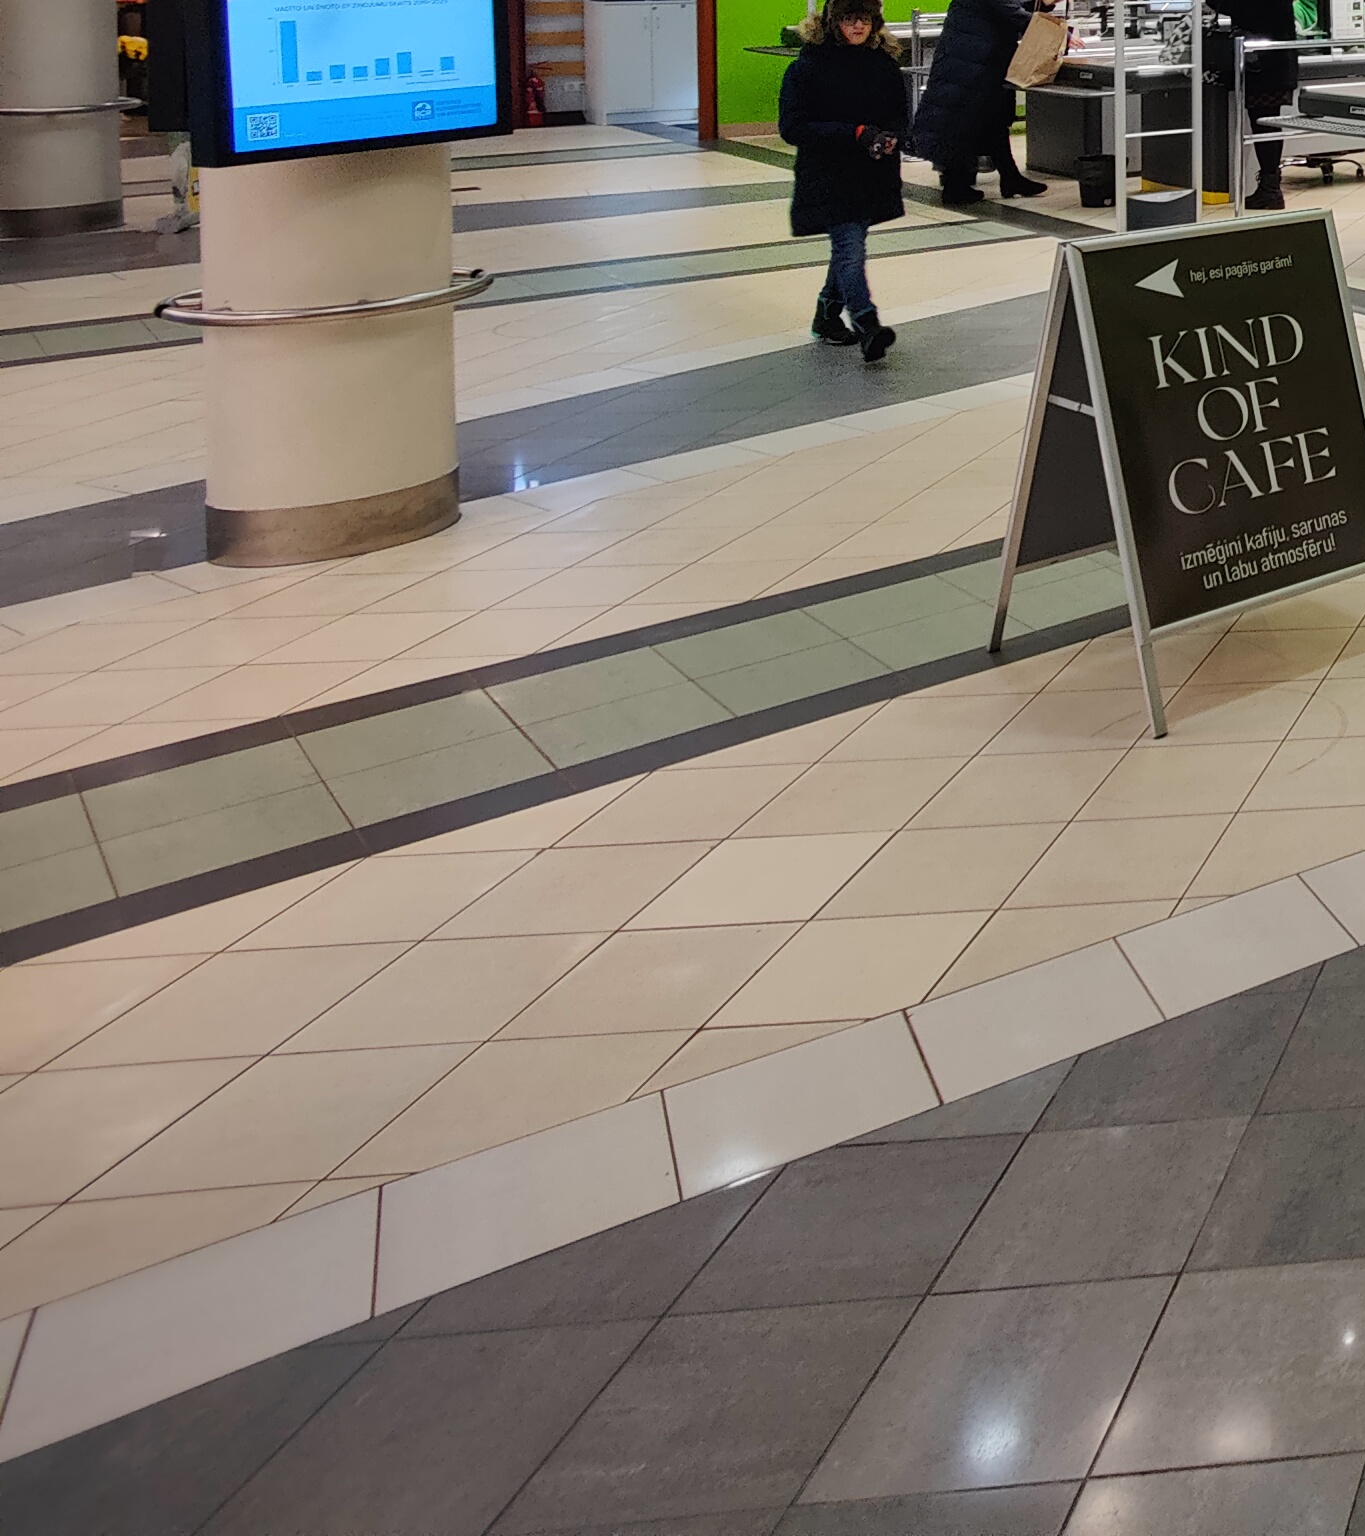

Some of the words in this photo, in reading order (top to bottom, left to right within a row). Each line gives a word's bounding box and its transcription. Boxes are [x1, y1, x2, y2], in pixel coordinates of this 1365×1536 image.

[1209, 265, 1224, 279] esi
[1225, 261, 1259, 279] pagājis
[1260, 255, 1293, 274] garām!
[1148, 314, 1304, 389] KIND
[1197, 376, 1281, 441] OF
[1168, 427, 1337, 515] CAFE
[1179, 535, 1243, 571] izmēģini
[1244, 525, 1290, 551] kafiju,
[1291, 510, 1348, 539] sarunas
[1202, 573, 1223, 590] un
[1224, 559, 1258, 583] labu
[1261, 533, 1337, 573] atmosfēru!
